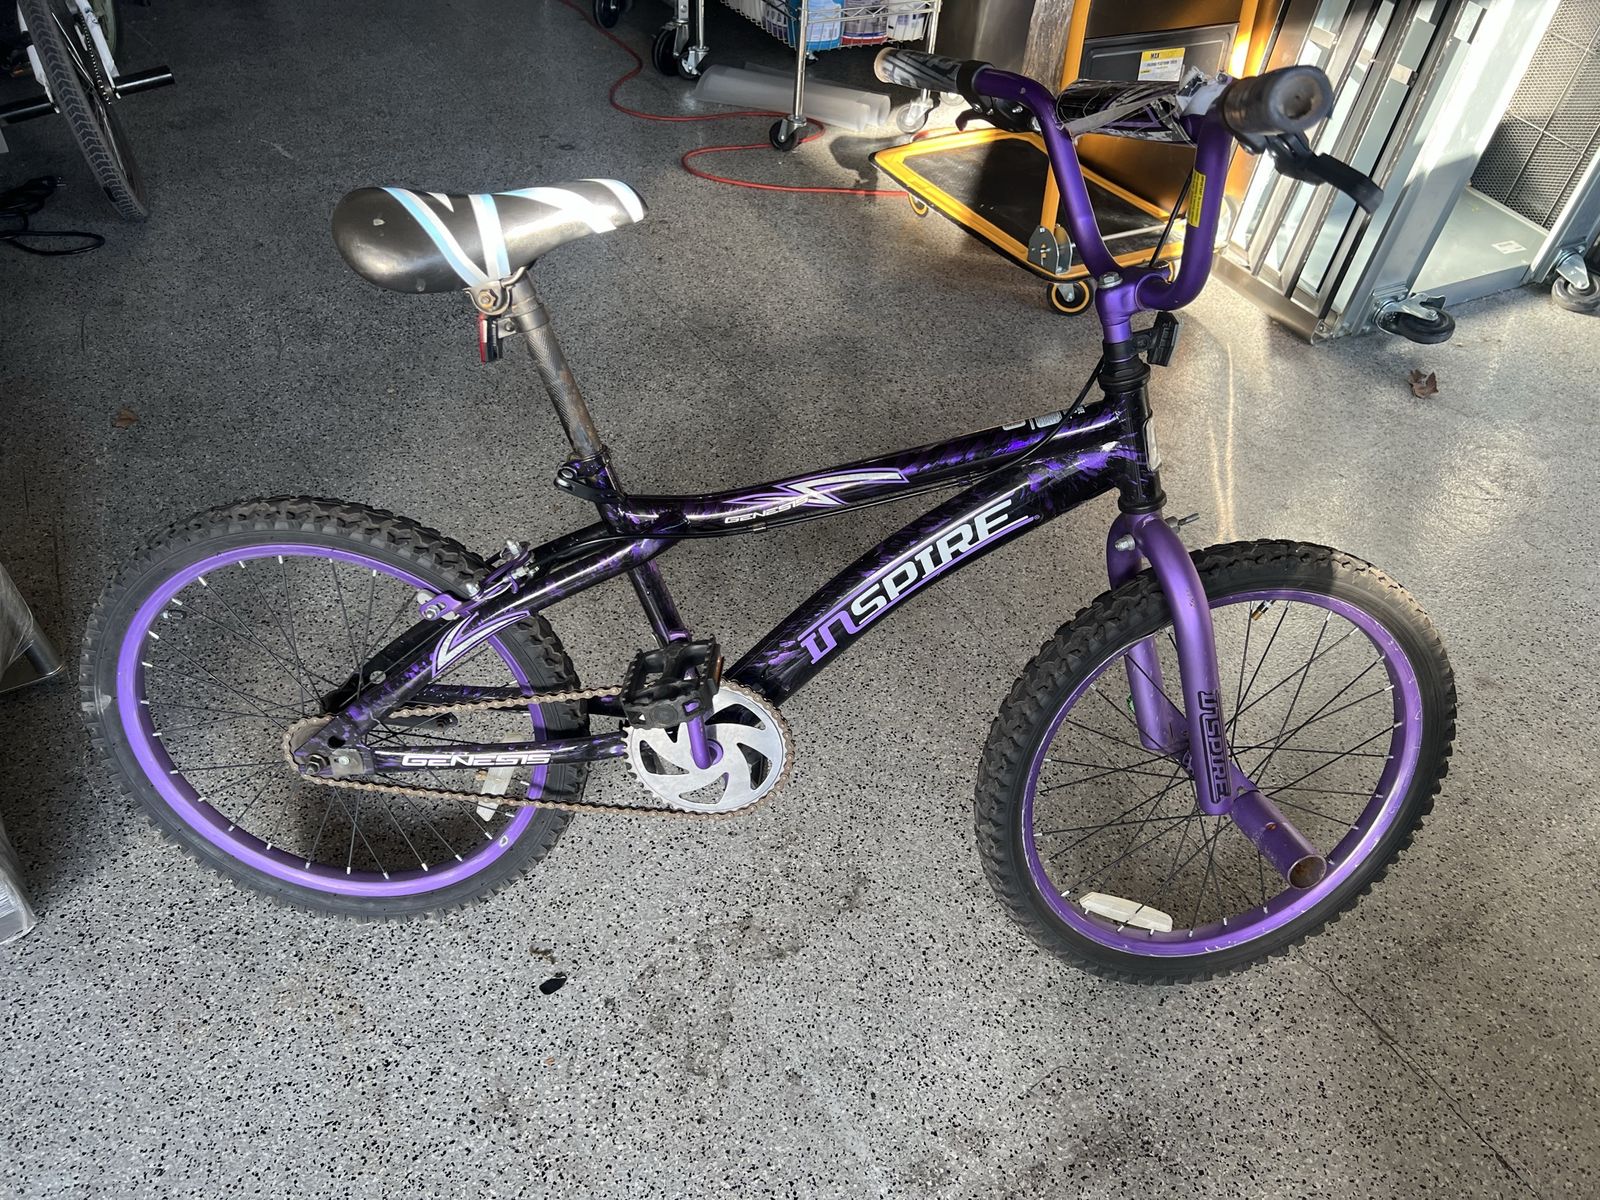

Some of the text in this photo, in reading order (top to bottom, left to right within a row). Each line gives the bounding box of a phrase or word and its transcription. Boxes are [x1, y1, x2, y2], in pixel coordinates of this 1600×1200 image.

[724, 494, 810, 525] GENESIS
[799, 498, 1014, 665] INSPIRE
[401, 753, 551, 767] GENESIS
[1198, 688, 1232, 804] INSPIRE
